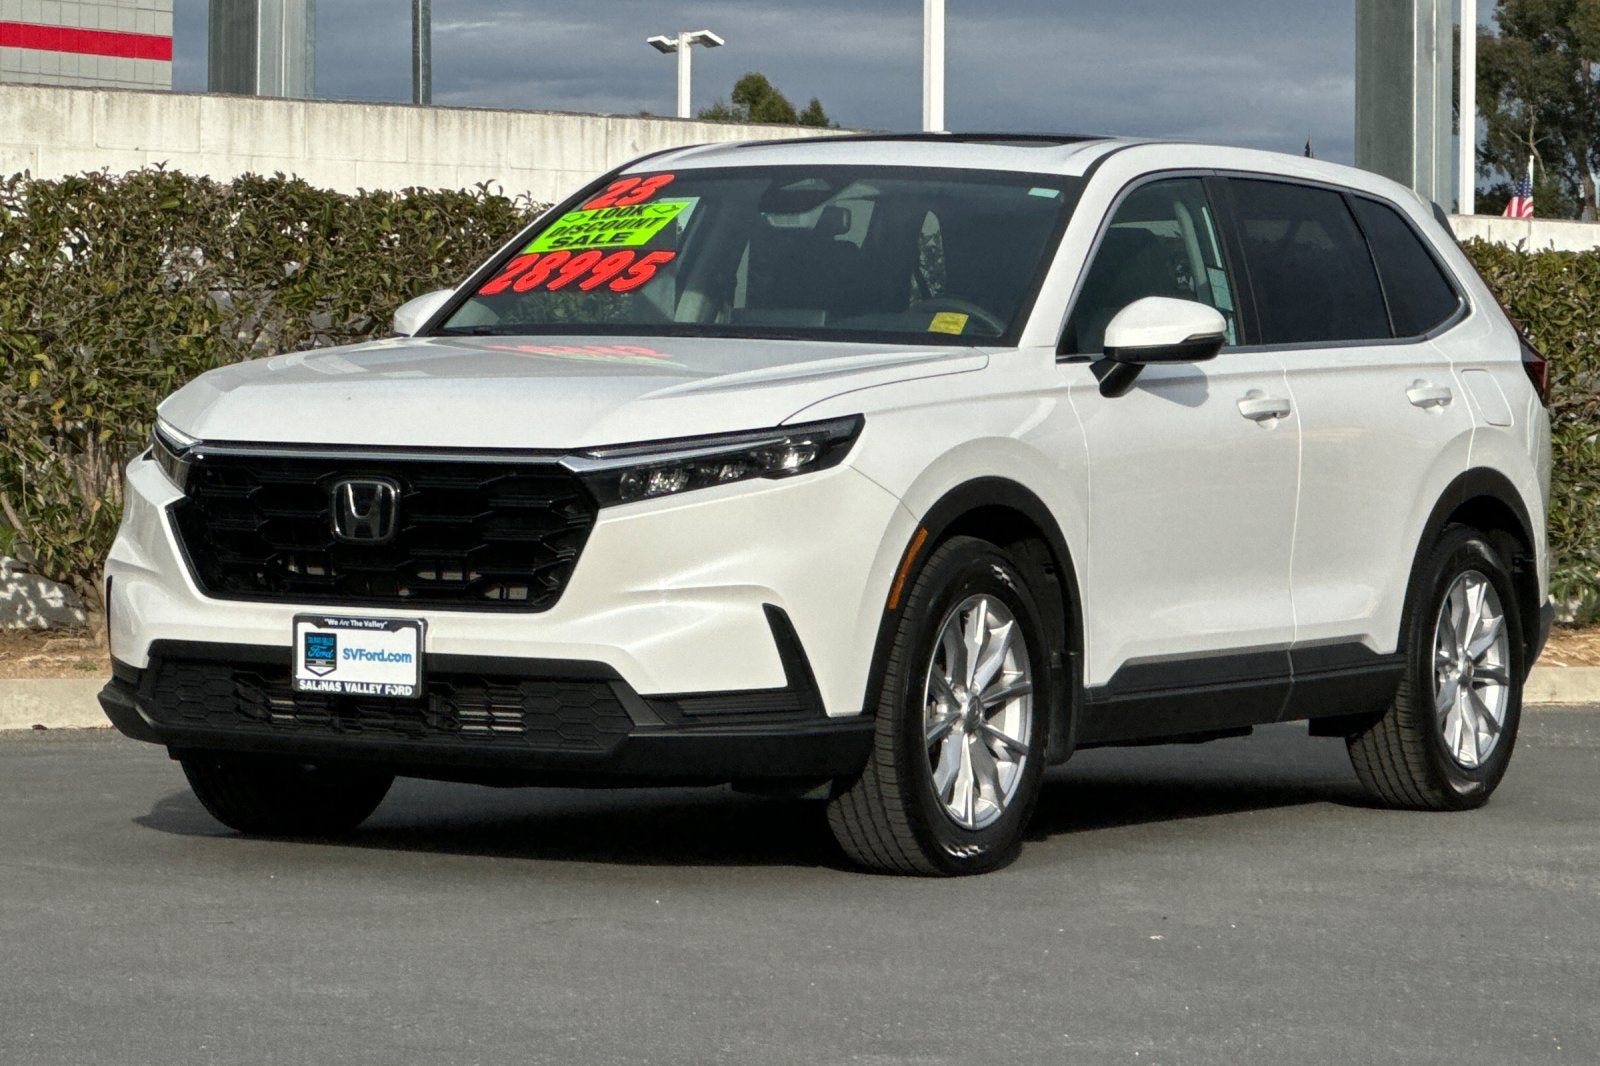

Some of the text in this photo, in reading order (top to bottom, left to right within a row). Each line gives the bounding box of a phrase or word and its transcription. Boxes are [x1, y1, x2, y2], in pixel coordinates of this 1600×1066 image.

[581, 174, 674, 210] 23
[588, 204, 652, 222] LOOK
[544, 216, 668, 240] DISCOUNT
[547, 232, 633, 249] SALE
[478, 250, 676, 295] 28995
[307, 645, 334, 658] Ford
[343, 648, 412, 663] SVFord.com
[299, 680, 413, 696] SALINAS VALLEY FORD
